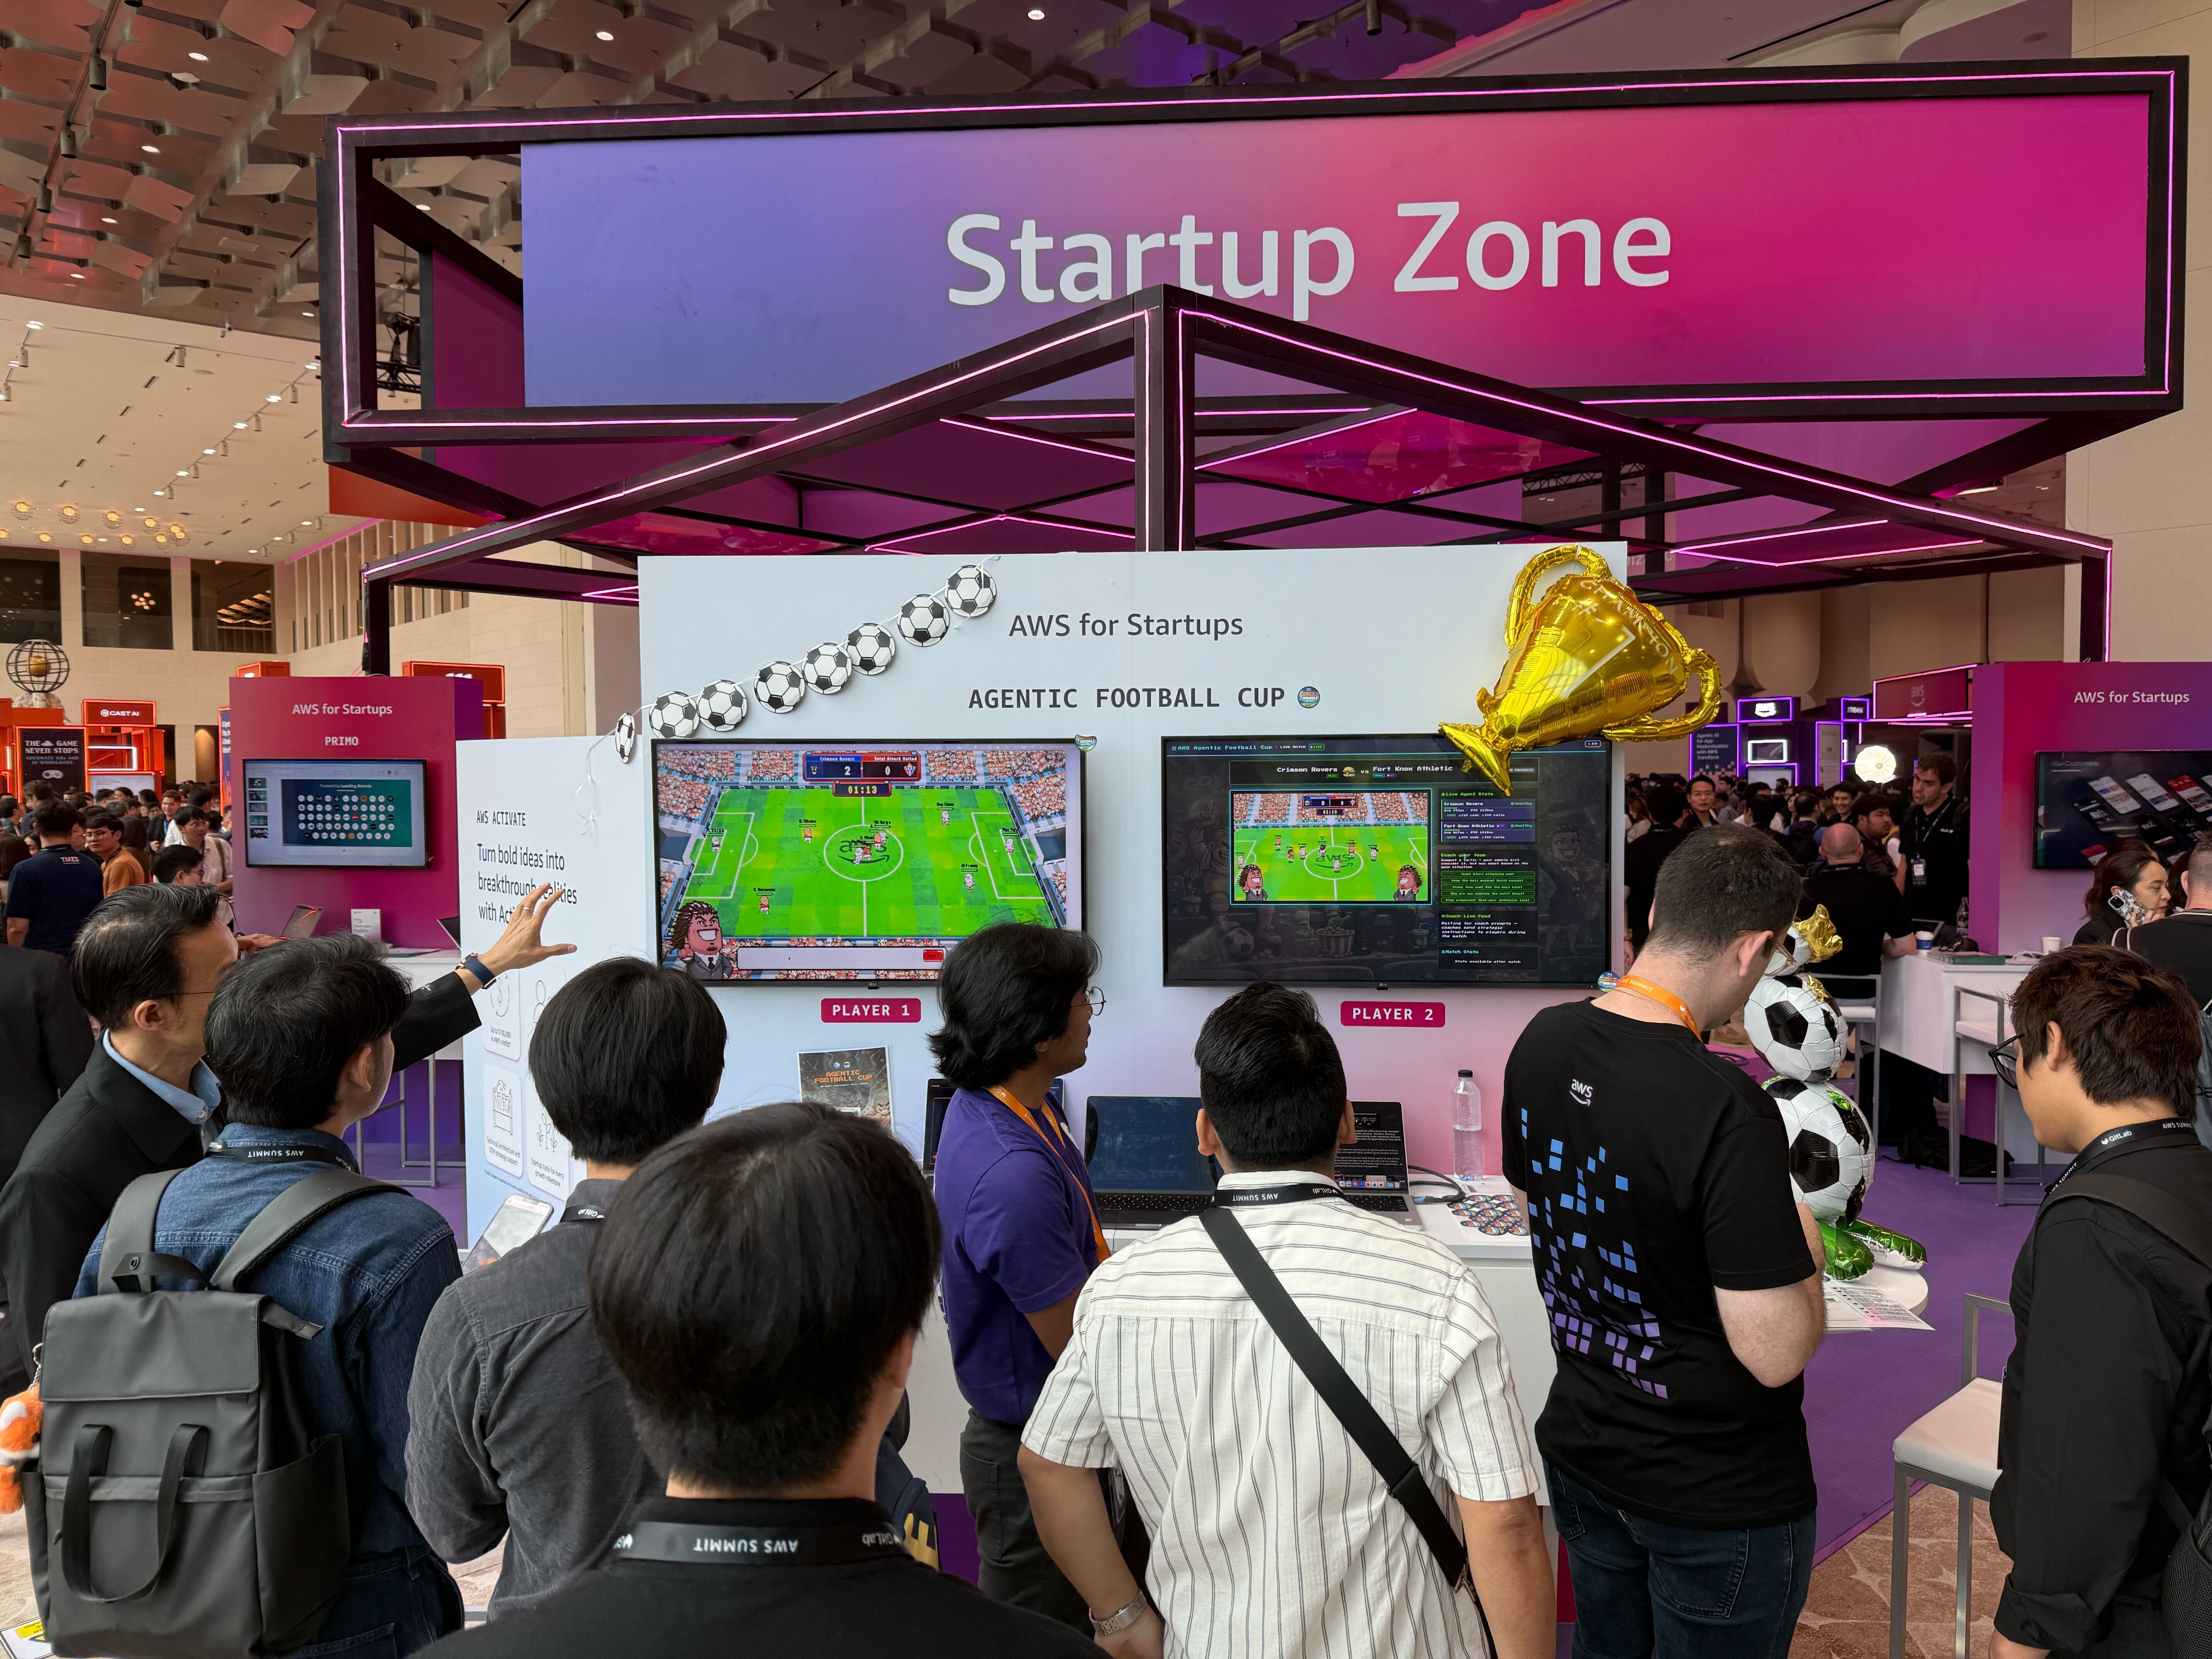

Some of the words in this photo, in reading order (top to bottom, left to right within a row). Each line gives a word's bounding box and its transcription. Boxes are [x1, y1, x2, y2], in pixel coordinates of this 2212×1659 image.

[948, 214, 1354, 321] Startup
[1395, 202, 1670, 292] Zone
[1009, 615, 1070, 637] AWS
[1079, 613, 1119, 636] for
[1128, 614, 1243, 641] Startups
[969, 689, 1077, 709] AGENTIC
[1097, 688, 1219, 708] FOOTBALL
[1238, 688, 1285, 708] CUP
[2074, 692, 2104, 703] AWS
[2109, 691, 2129, 703] for
[2133, 692, 2190, 705] Startups
[292, 704, 319, 714] AWS
[322, 704, 339, 714] for
[343, 704, 392, 716] Startups
[325, 737, 358, 746] PRIMO
[844, 766, 850, 776] 2
[885, 766, 891, 776] 0
[848, 786, 877, 794] 01:13
[477, 810, 488, 824] AWS
[492, 811, 526, 826] ACTIVATE
[477, 843, 495, 862] Turn
[498, 844, 517, 865] bold
[520, 847, 543, 868] ideas
[546, 849, 565, 870] into
[479, 902, 496, 921] with
[1629, 979, 1654, 992] SUMMIT
[833, 1005, 890, 1016] PLAYER
[902, 1005, 910, 1016] 1
[1353, 1008, 1412, 1020] PLAYER
[1425, 1009, 1433, 1020] 2
[1571, 1079, 1593, 1097] aws
[2109, 1130, 2132, 1142] GitLab
[693, 1537, 758, 1553] SUMMIT
[764, 1539, 799, 1553] AWS
[862, 1533, 893, 1546] GitLab
